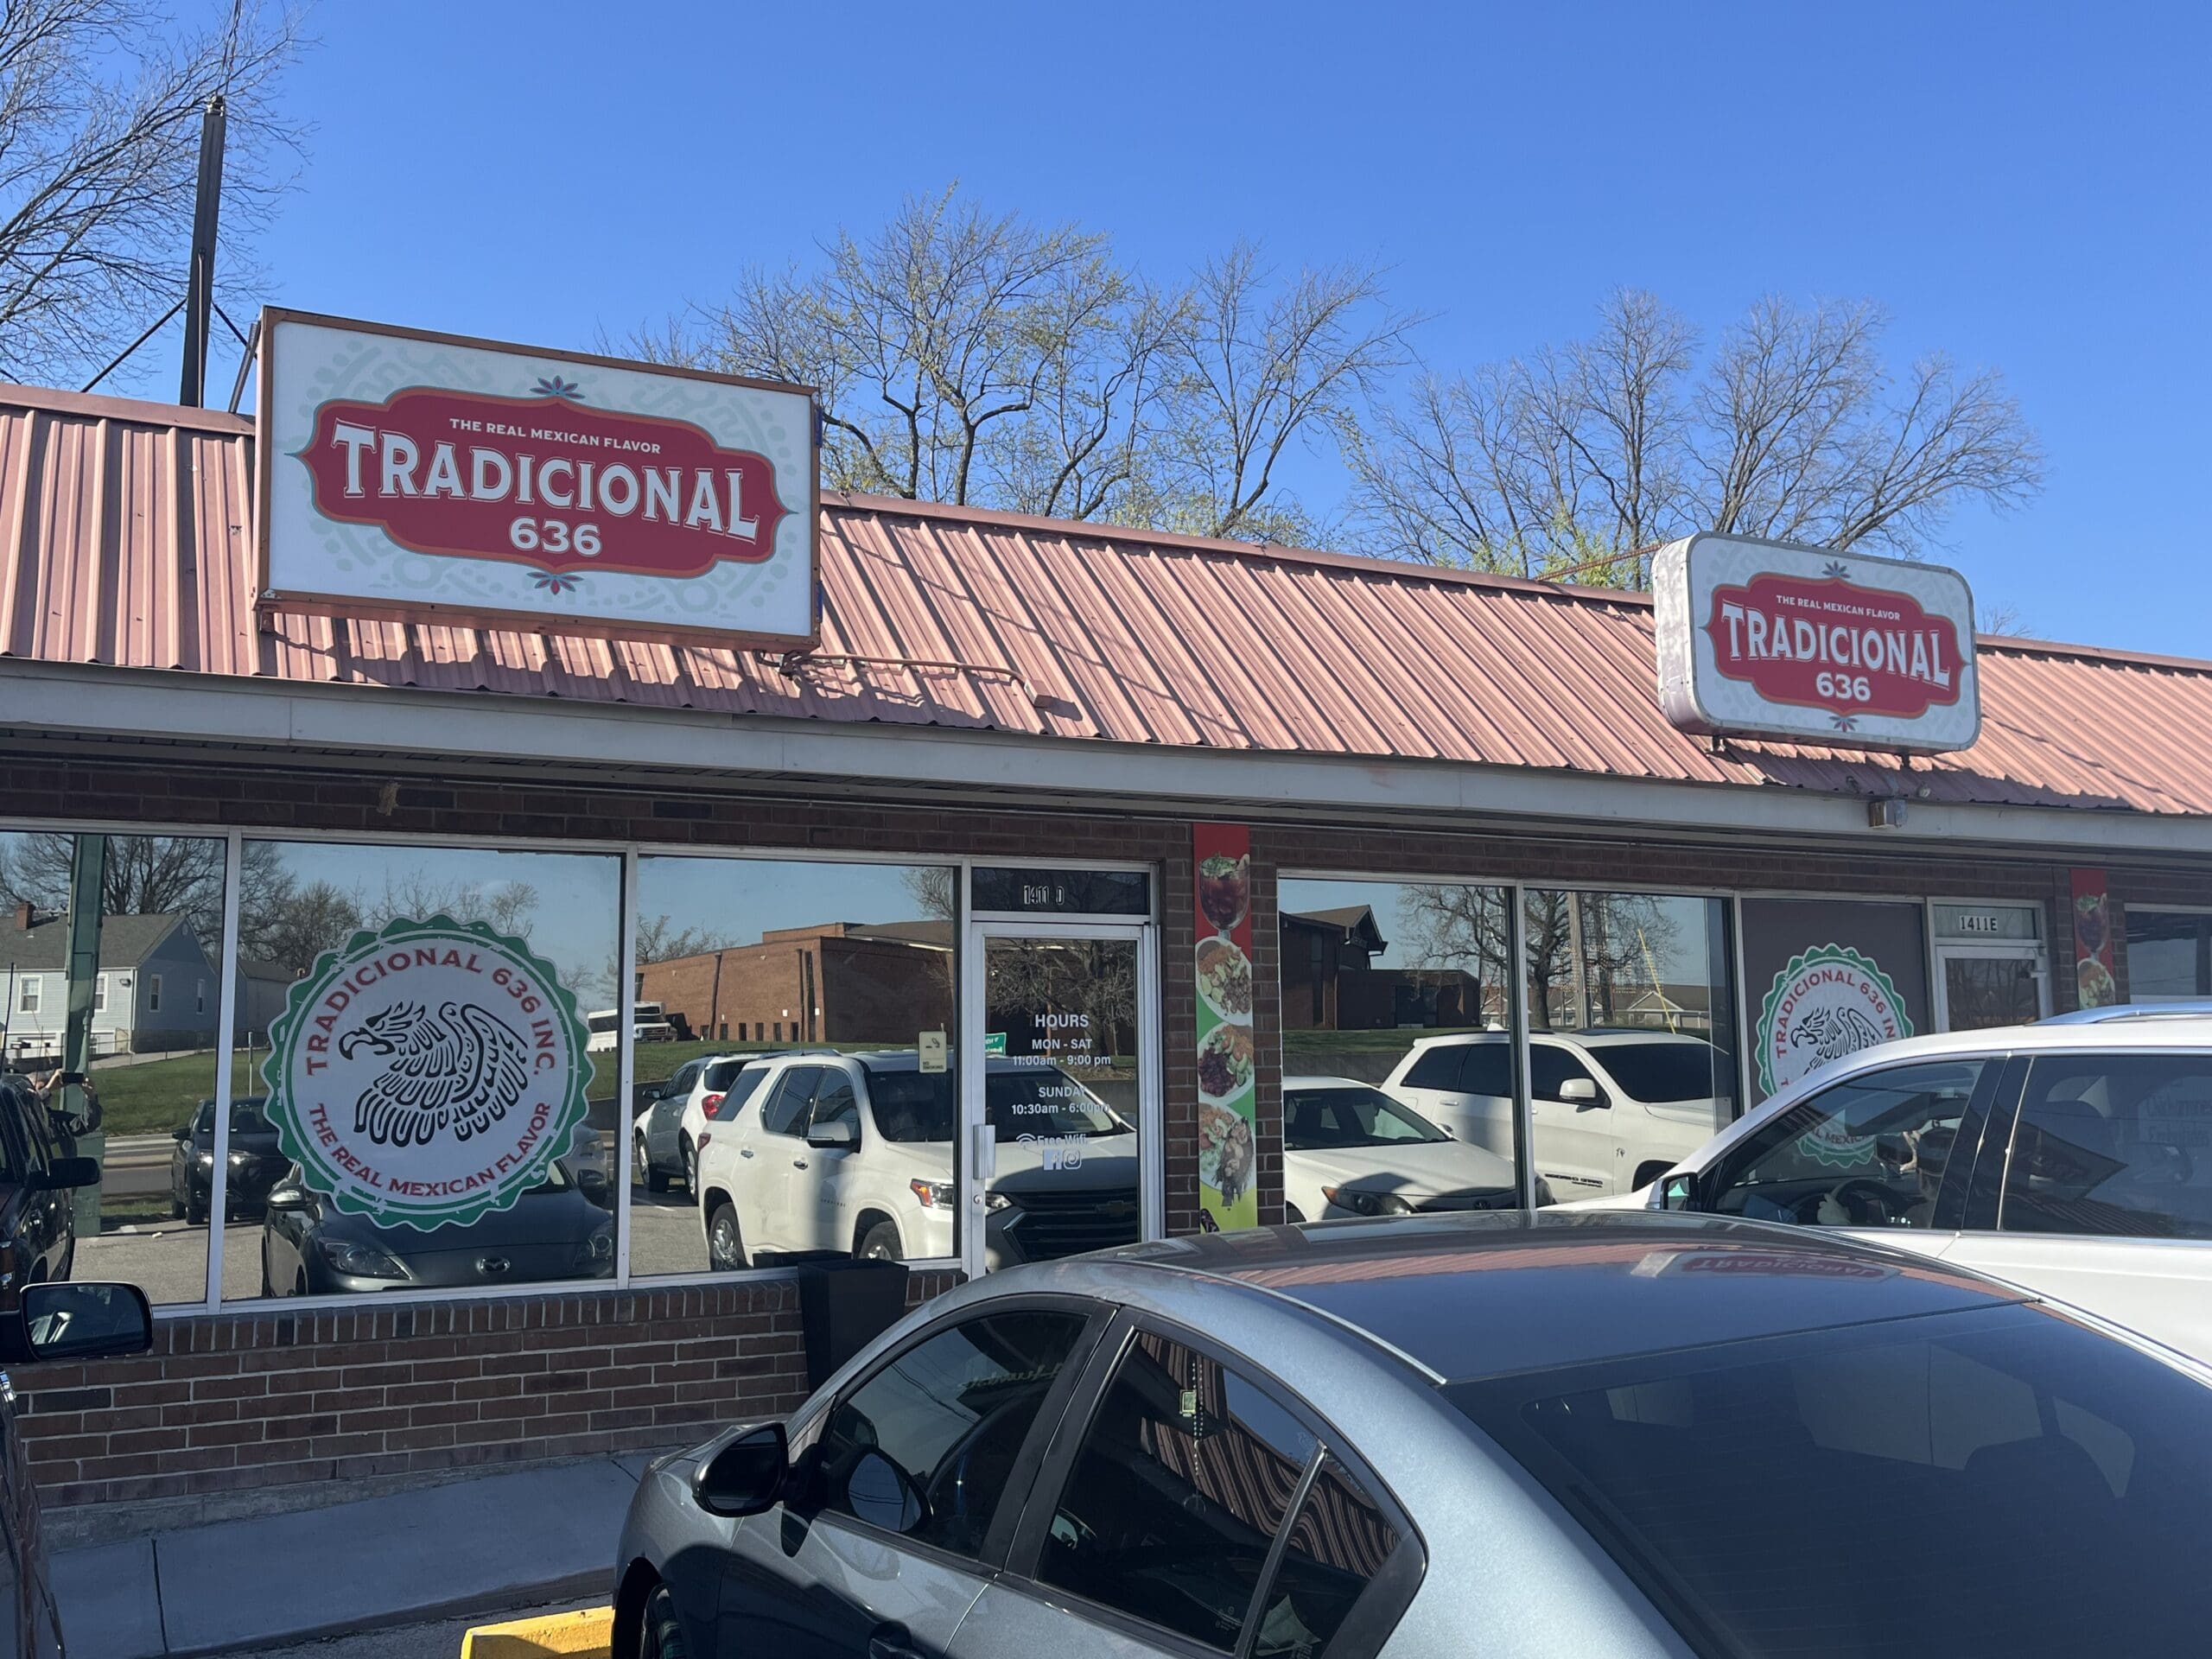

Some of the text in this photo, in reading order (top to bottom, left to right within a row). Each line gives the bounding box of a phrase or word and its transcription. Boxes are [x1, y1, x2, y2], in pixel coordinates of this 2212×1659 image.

[449, 418, 661, 454] THE REAL MEXICAN FLAVOR
[331, 416, 760, 544] TRADICIONAL
[509, 516, 602, 556] 636
[1777, 594, 1900, 621] THE REAL MEXICAN FLAVOR
[1721, 598, 1950, 690] TRADICIONAL
[1816, 672, 1871, 702] 636
[1023, 885, 1050, 905] 1411
[1961, 917, 1997, 931] 1411E
[306, 948, 556, 1076] TRADICIONAL 636 INC.
[1034, 1014, 1089, 1027] HOURS
[1777, 969, 1896, 1058] TRADICIONAL 636 IN
[1032, 1039, 1060, 1050] MON
[1071, 1039, 1092, 1050] SAT
[1012, 1055, 1057, 1065] 11:00am
[1067, 1055, 1091, 1065] 9:00
[1094, 1057, 1111, 1067] pm
[1038, 1086, 1086, 1097] SUNDAY
[1011, 1103, 1058, 1115] 10:30am
[309, 1103, 551, 1198] THE REAL MEXICAN FLAVOR
